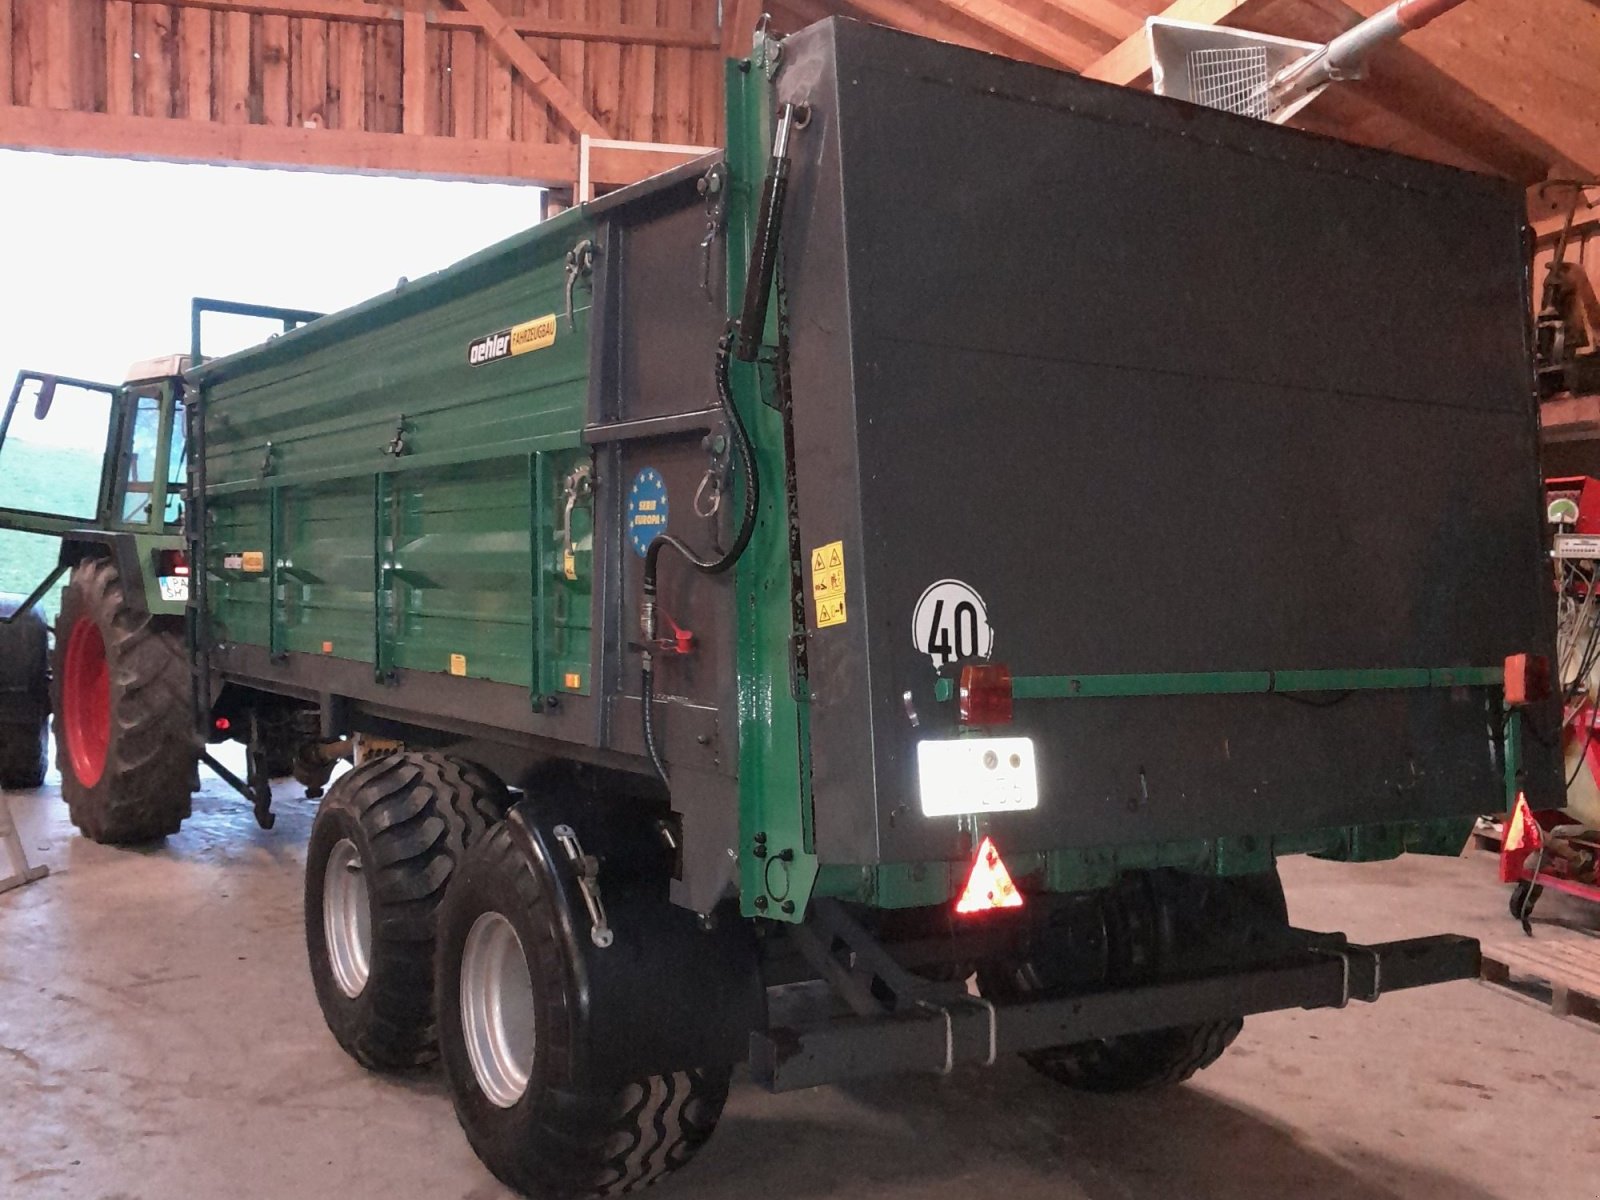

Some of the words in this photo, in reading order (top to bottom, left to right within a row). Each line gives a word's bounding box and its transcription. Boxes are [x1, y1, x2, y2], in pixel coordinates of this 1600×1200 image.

[470, 334, 510, 364] oehler
[512, 321, 555, 345] FAHRZEUGBAU
[634, 514, 660, 525] EUROPA
[928, 600, 979, 663] 40
